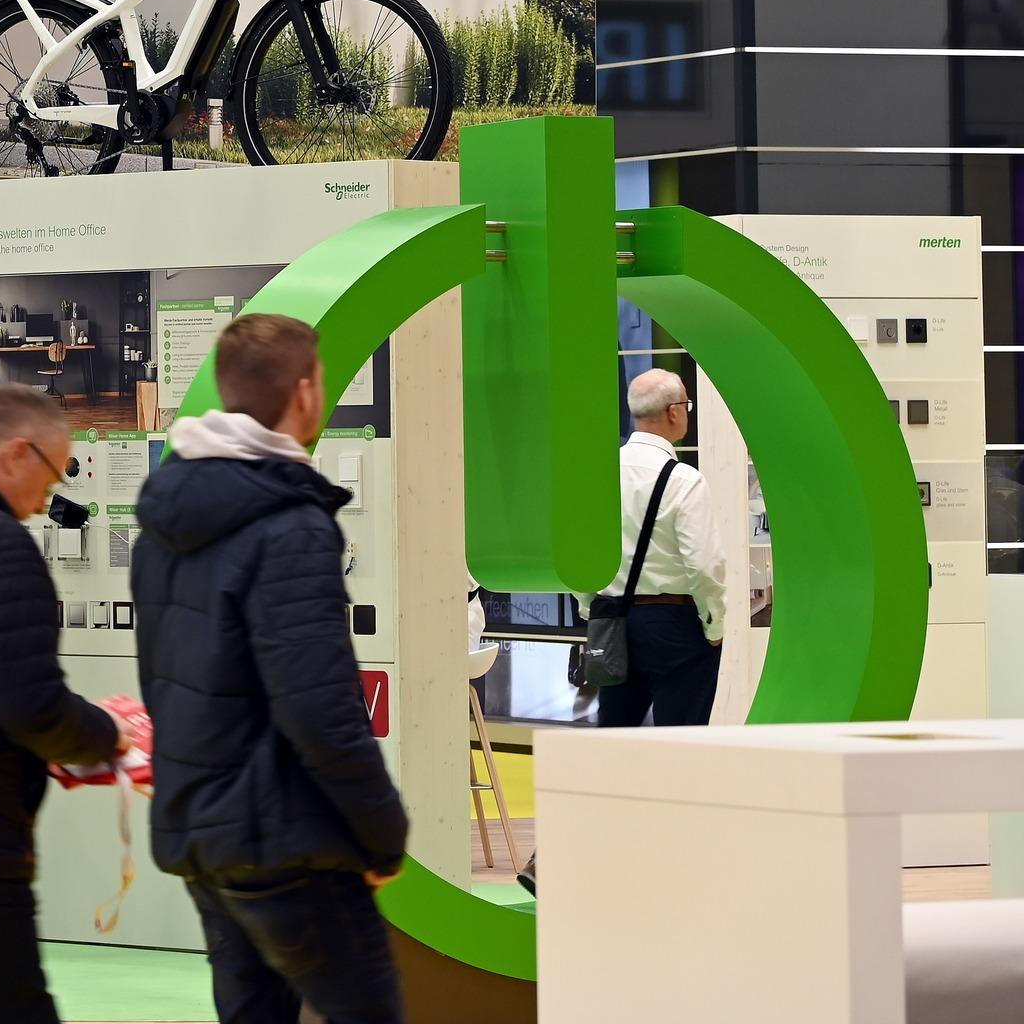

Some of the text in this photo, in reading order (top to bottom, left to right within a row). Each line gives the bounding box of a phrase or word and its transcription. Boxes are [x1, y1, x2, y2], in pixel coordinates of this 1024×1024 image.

[325, 182, 370, 193] Schneider
[34, 226, 46, 239] im
[48, 225, 76, 238] Home
[78, 223, 107, 236] Office
[11, 244, 32, 254] home
[33, 243, 54, 253] office
[786, 244, 809, 253] Design
[918, 237, 961, 249] merten
[793, 256, 828, 267] D-Antik
[796, 272, 825, 281] Antique
[484, 595, 511, 617] rfect
